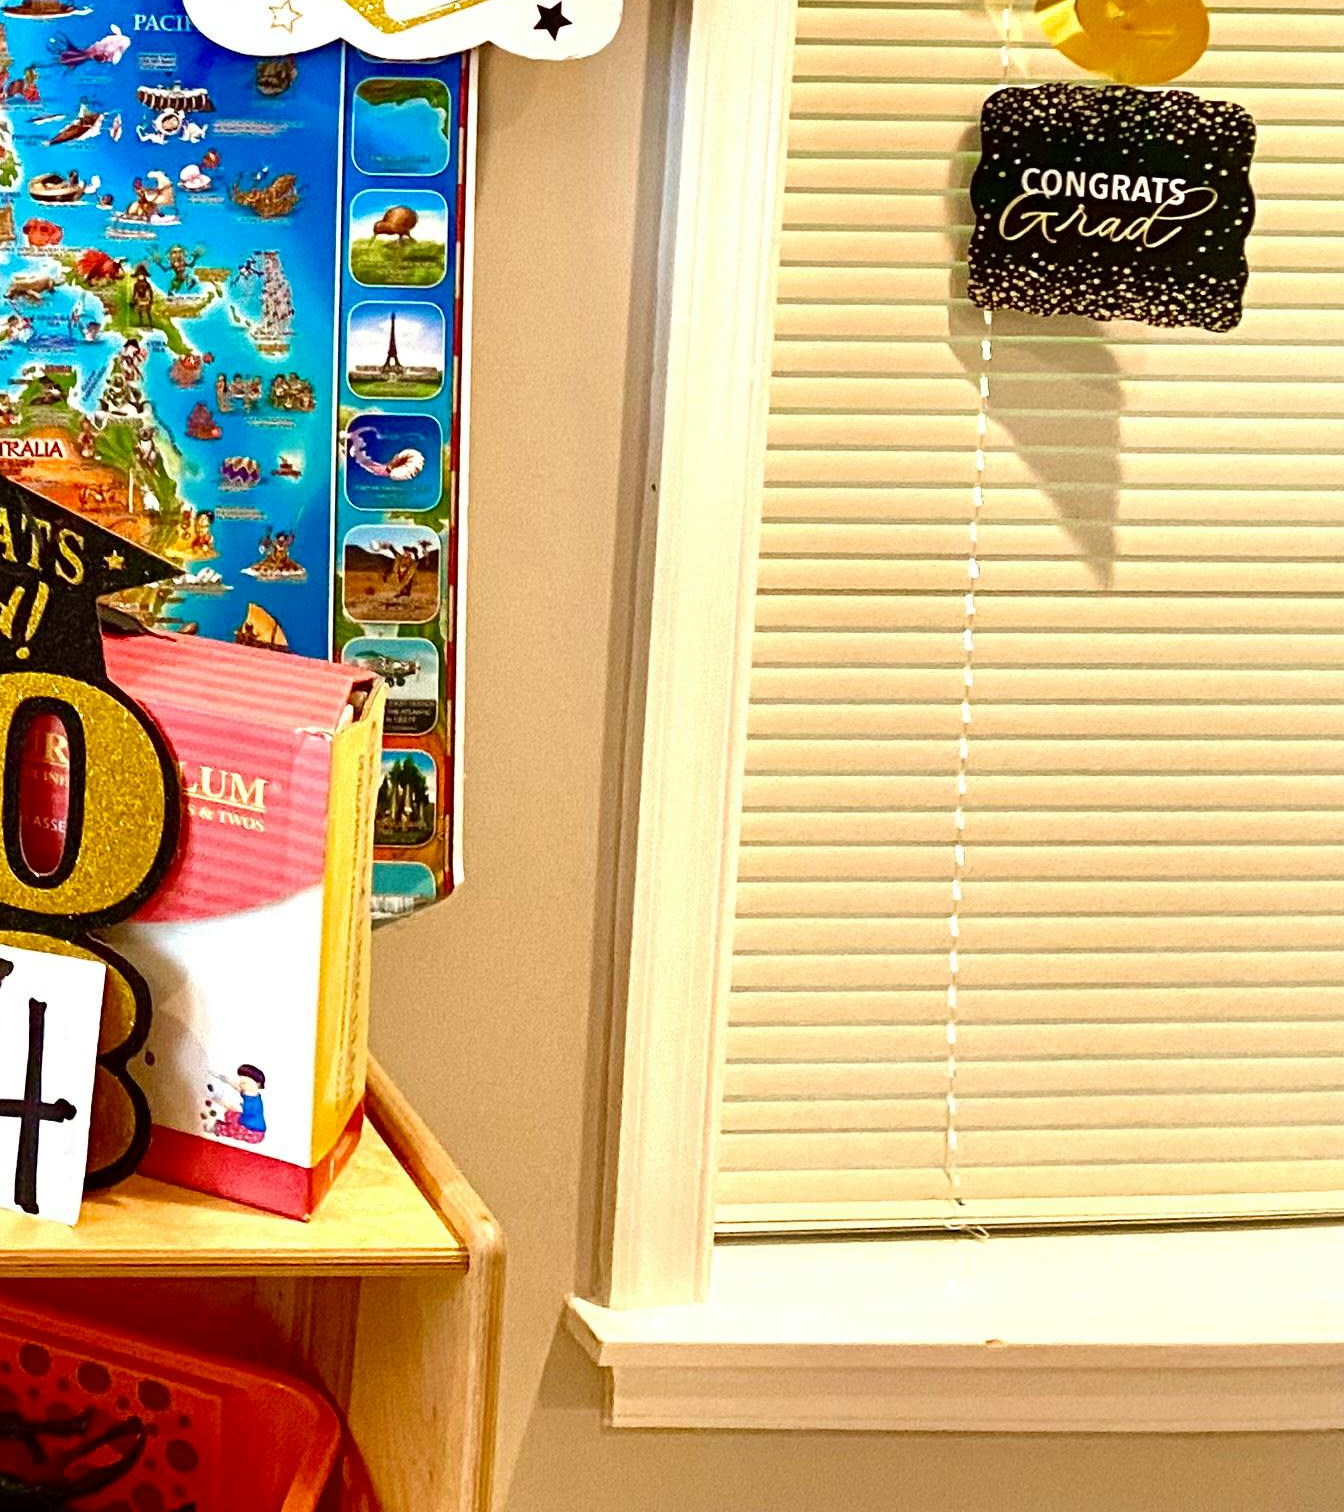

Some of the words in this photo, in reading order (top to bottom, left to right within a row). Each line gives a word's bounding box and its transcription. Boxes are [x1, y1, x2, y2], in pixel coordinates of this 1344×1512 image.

[132, 14, 192, 32] PACI
[1021, 168, 1187, 206] CONGRATS
[999, 187, 1218, 248] Grad
